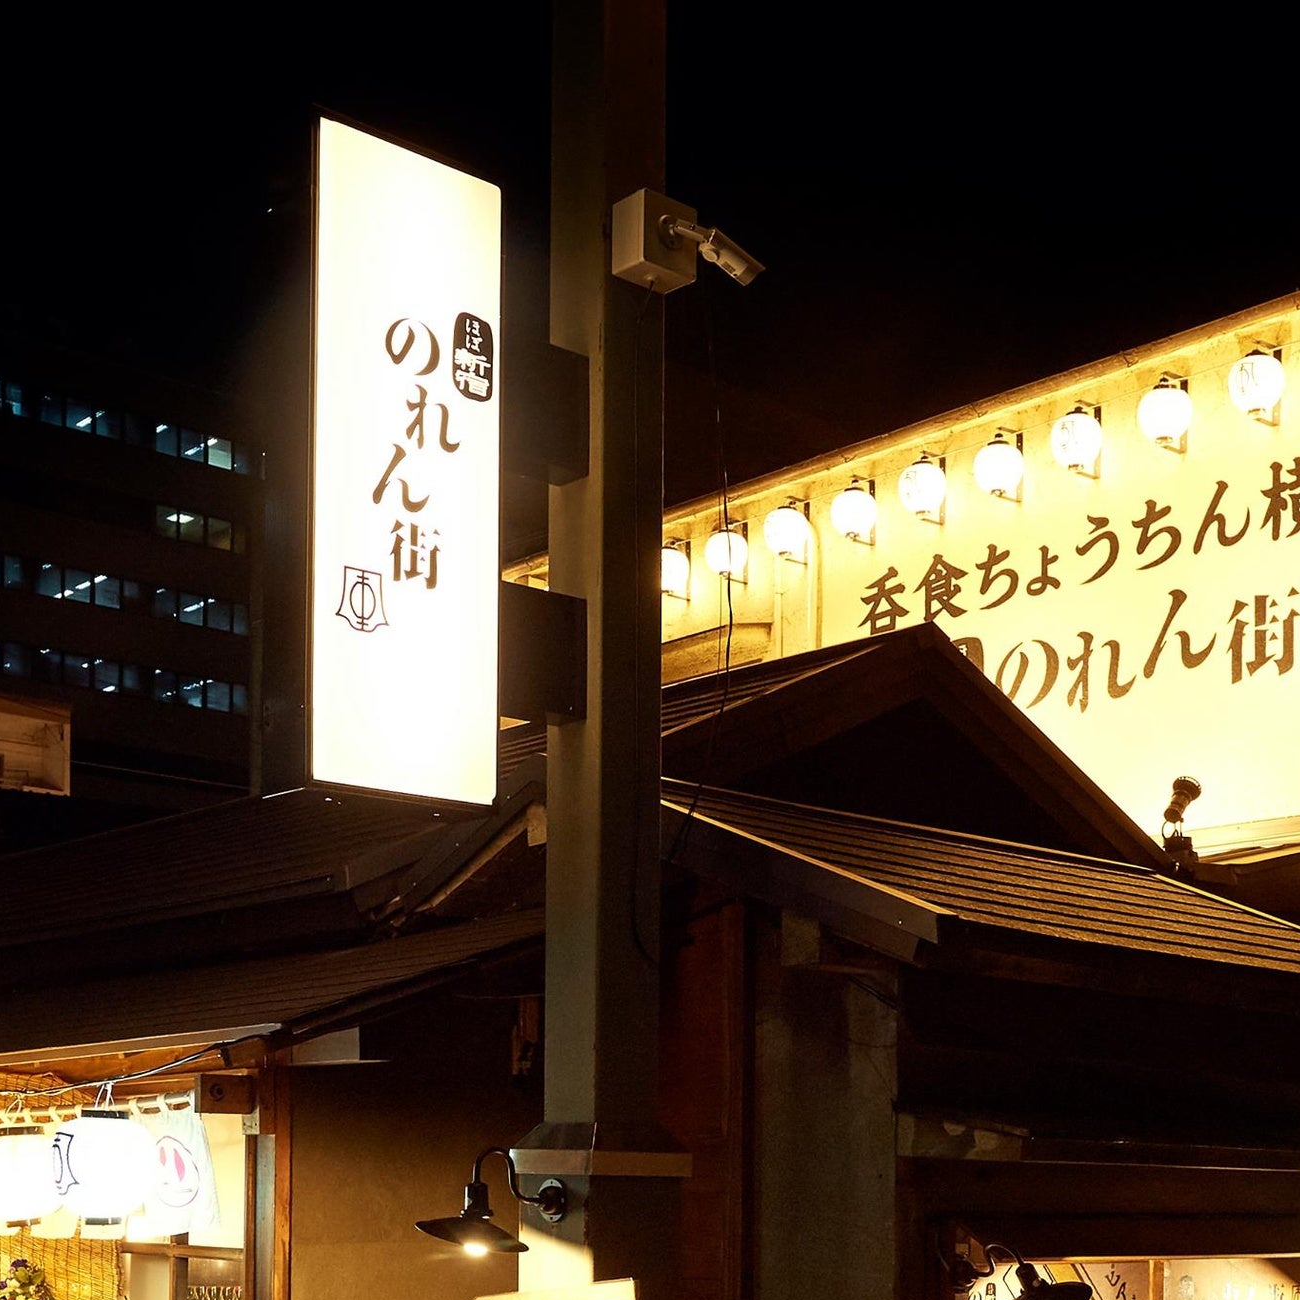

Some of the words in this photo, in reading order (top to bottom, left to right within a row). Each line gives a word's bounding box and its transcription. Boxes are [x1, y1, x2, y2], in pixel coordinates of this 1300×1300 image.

[453, 318, 492, 398] ほぼ新宿
[371, 317, 461, 590] のれん街
